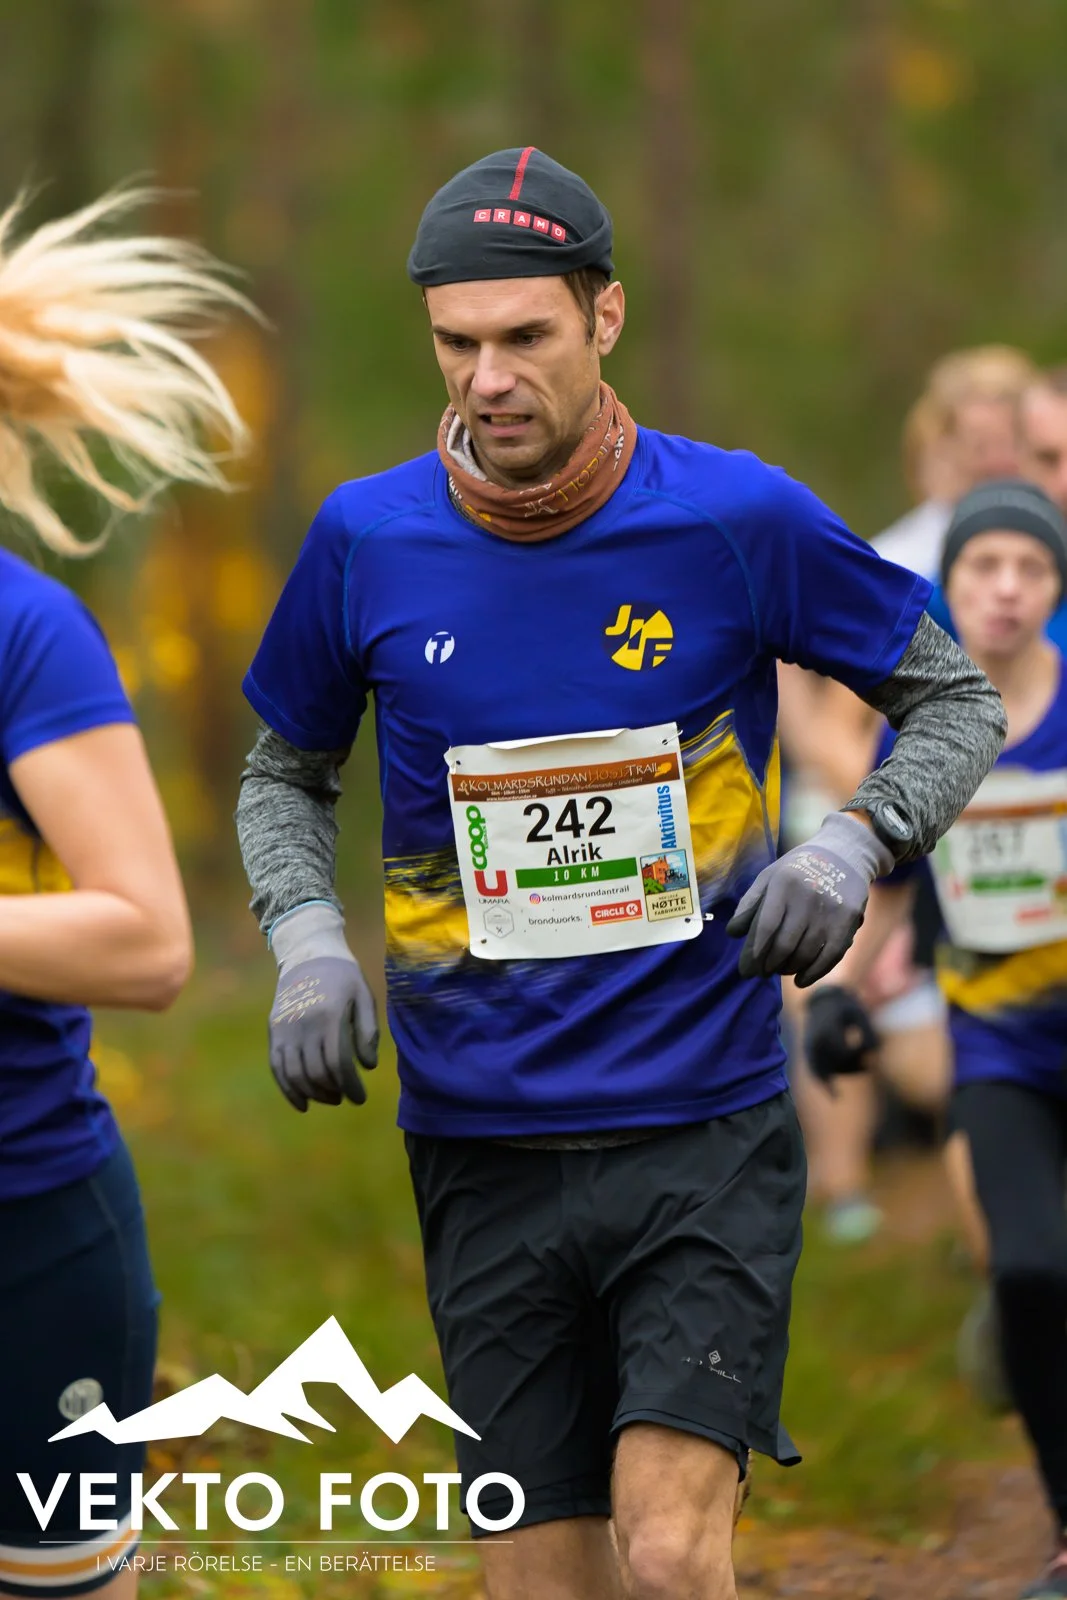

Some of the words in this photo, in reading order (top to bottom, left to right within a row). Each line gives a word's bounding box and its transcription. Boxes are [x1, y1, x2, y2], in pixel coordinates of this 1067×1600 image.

[476, 210, 563, 238] CRAMO
[523, 796, 617, 843] 242
[656, 785, 678, 849] Aktivitus
[466, 804, 488, 871] coop
[546, 842, 603, 866] Alrik
[553, 870, 570, 882] 10
[580, 865, 601, 879] KM
[541, 884, 630, 903] kolmardsrundantrail
[651, 896, 687, 910] NØTTE
[594, 906, 625, 919] CIRCLE
